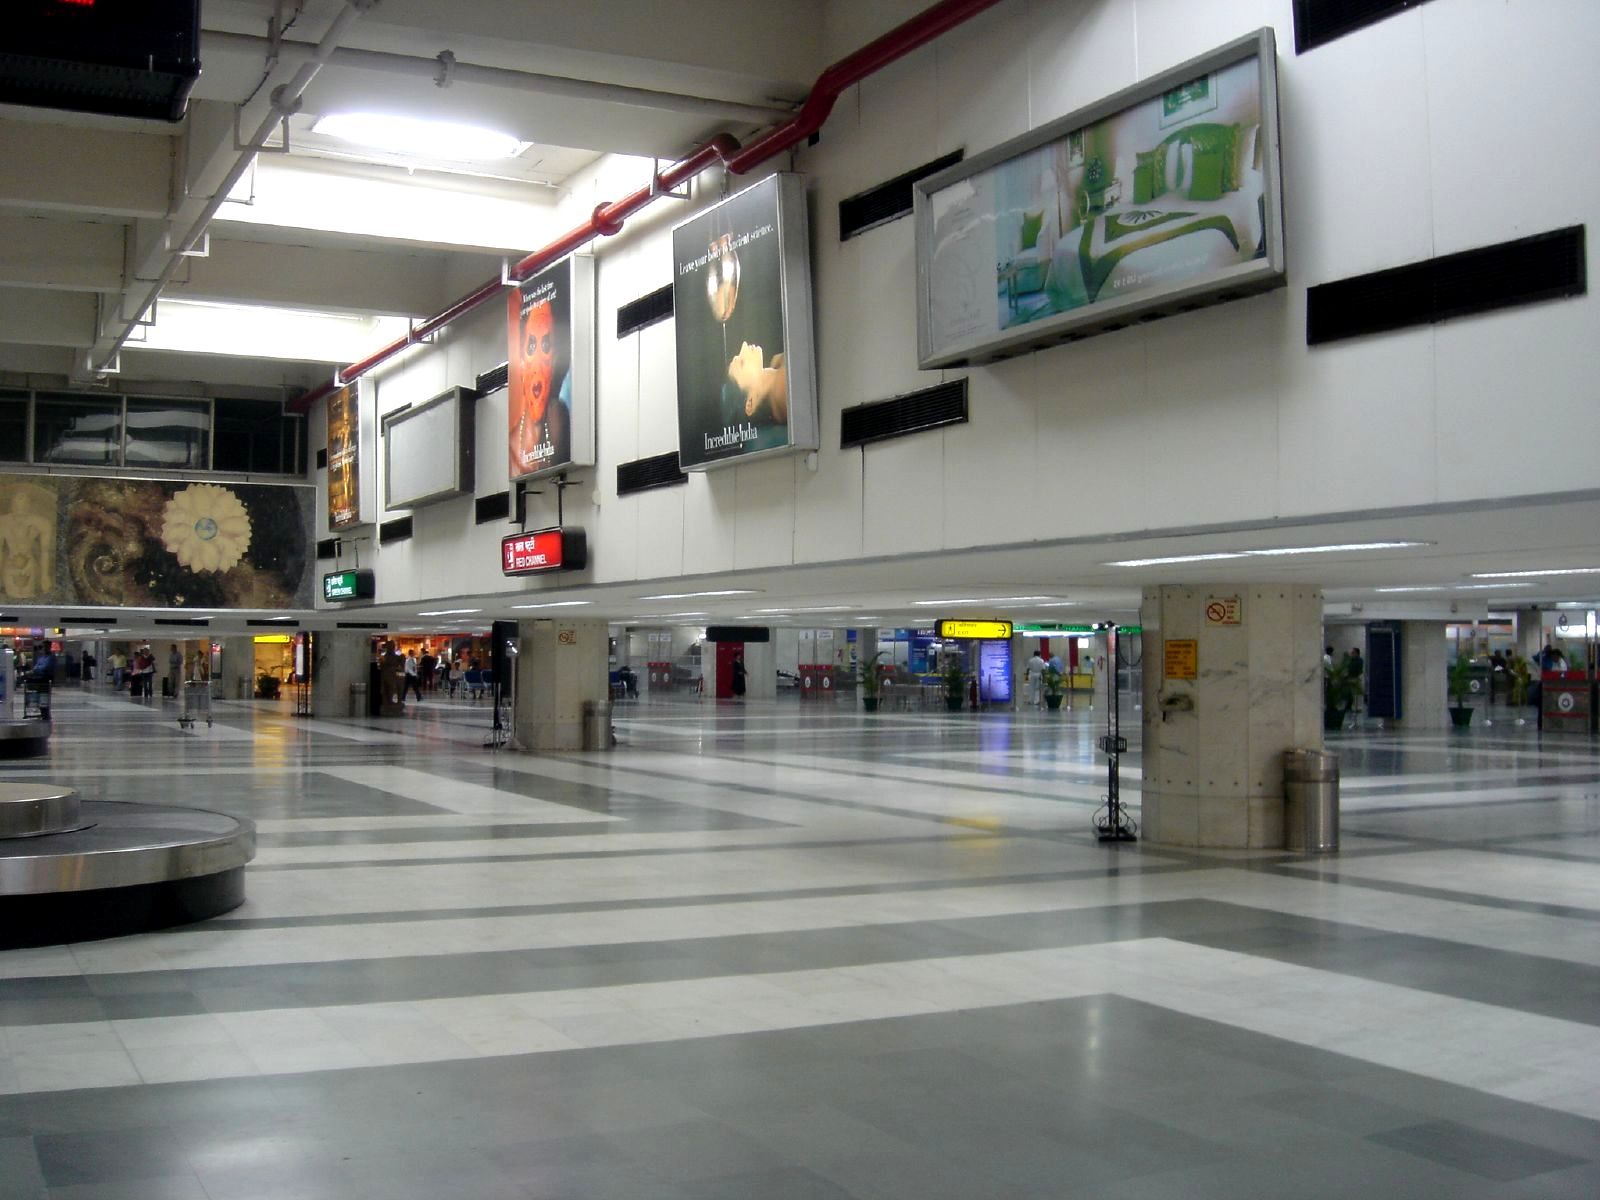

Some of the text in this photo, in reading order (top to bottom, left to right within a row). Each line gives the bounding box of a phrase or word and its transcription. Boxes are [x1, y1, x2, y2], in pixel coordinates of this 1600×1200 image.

[679, 261, 694, 275] Leave
[694, 255, 707, 271] your
[704, 425, 740, 450] Incredible
[515, 554, 547, 567] RED CHANNEL
